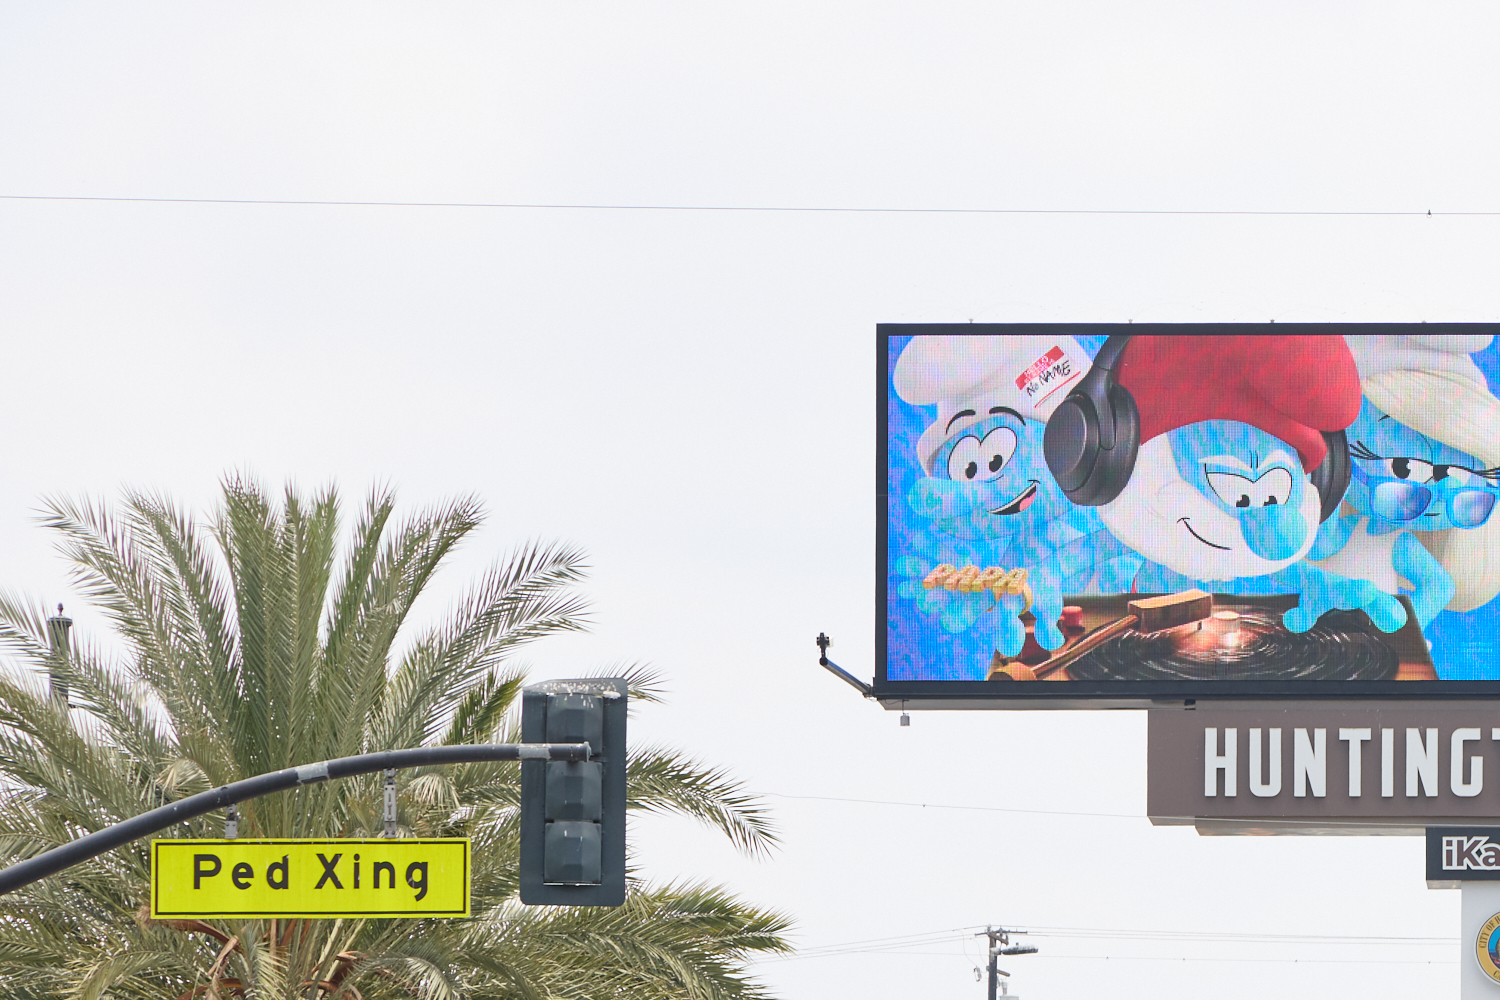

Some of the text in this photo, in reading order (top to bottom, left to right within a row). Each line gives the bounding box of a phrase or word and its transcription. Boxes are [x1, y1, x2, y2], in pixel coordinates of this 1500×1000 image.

[1039, 360, 1070, 386] NAME
[922, 563, 1028, 596] PAPA
[193, 853, 430, 902] Ped Xing
[1478, 931, 1489, 949] CITY
[1486, 920, 1496, 931] OF
